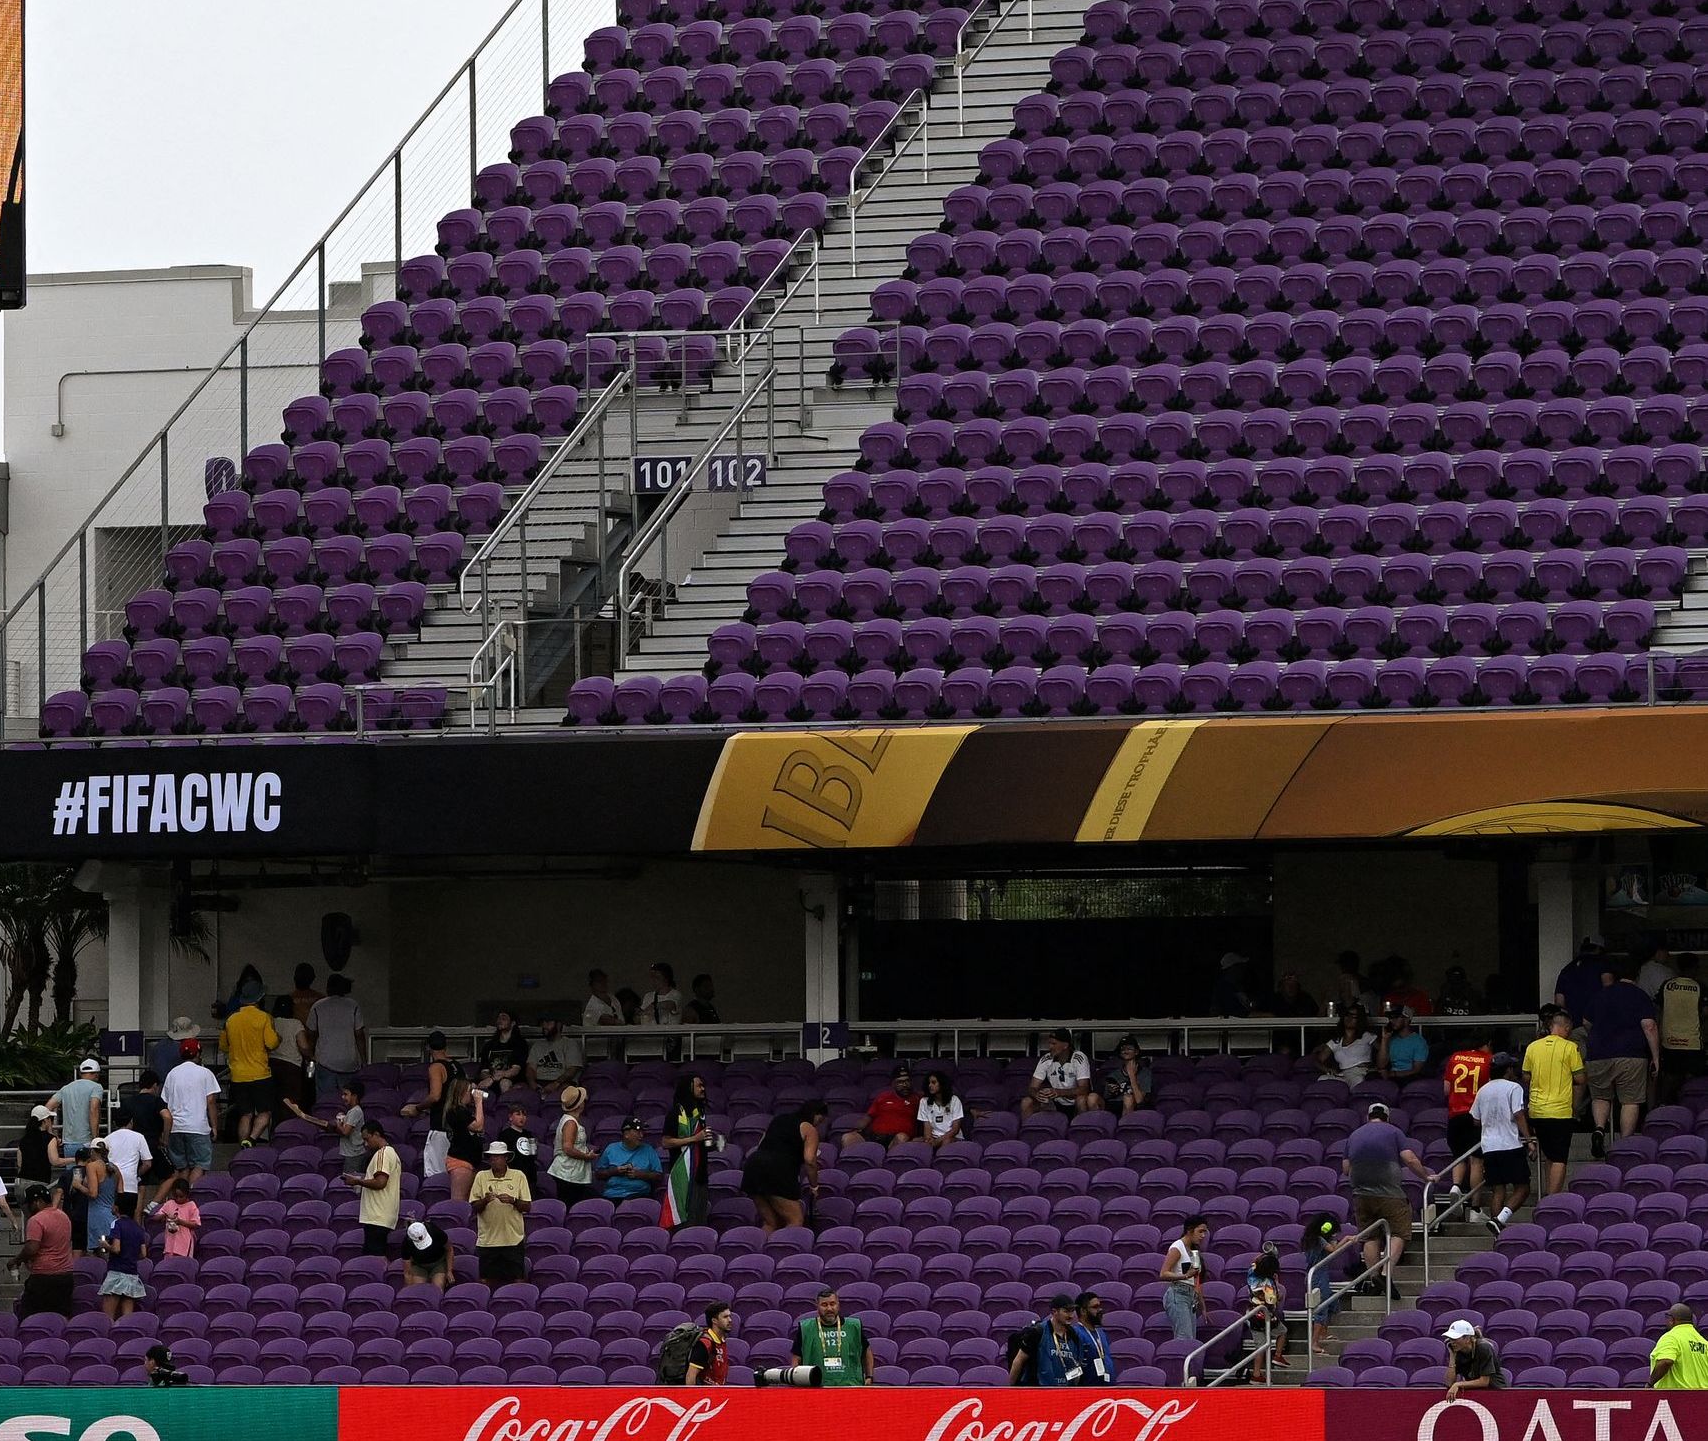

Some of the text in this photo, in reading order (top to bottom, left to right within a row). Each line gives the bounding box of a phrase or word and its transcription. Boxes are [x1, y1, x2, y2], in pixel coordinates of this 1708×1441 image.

[711, 458, 762, 487] 102
[53, 771, 282, 835] #FIFACWC
[118, 1034, 126, 1053] 1
[822, 1027, 831, 1045] 2
[1452, 1063, 1482, 1095] 21
[820, 1330, 847, 1338] HOTO
